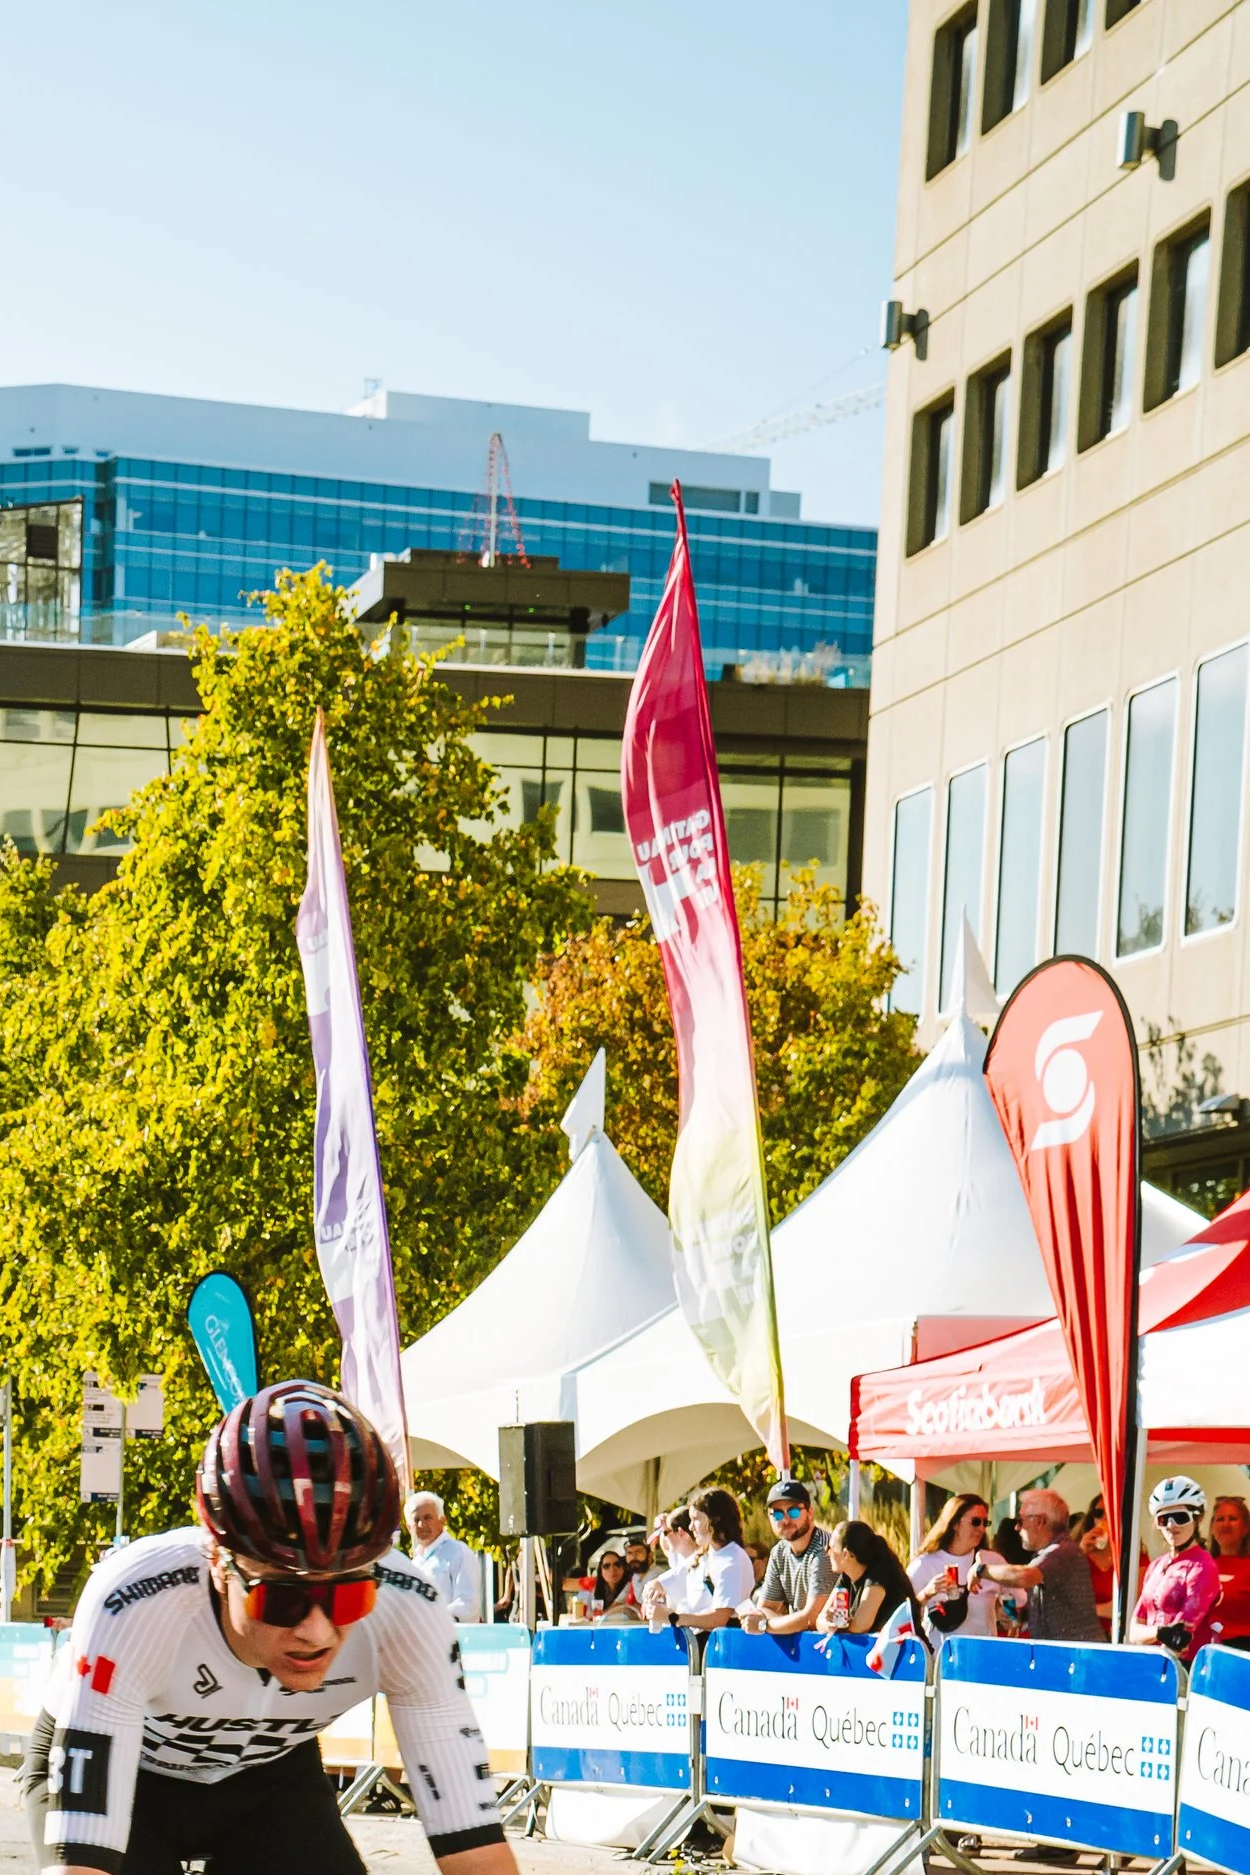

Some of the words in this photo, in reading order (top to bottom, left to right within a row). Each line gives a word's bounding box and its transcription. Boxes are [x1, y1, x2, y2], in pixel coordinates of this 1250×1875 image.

[904, 1377, 1047, 1437] Scotiabank
[103, 1566, 200, 1615] SHIMANO
[540, 1686, 599, 1726] Canada
[608, 1691, 663, 1732] Québec
[718, 1691, 798, 1741] Canada
[811, 1704, 888, 1749] Québec
[953, 1706, 1038, 1765] Canada
[1052, 1725, 1136, 1777] Québec
